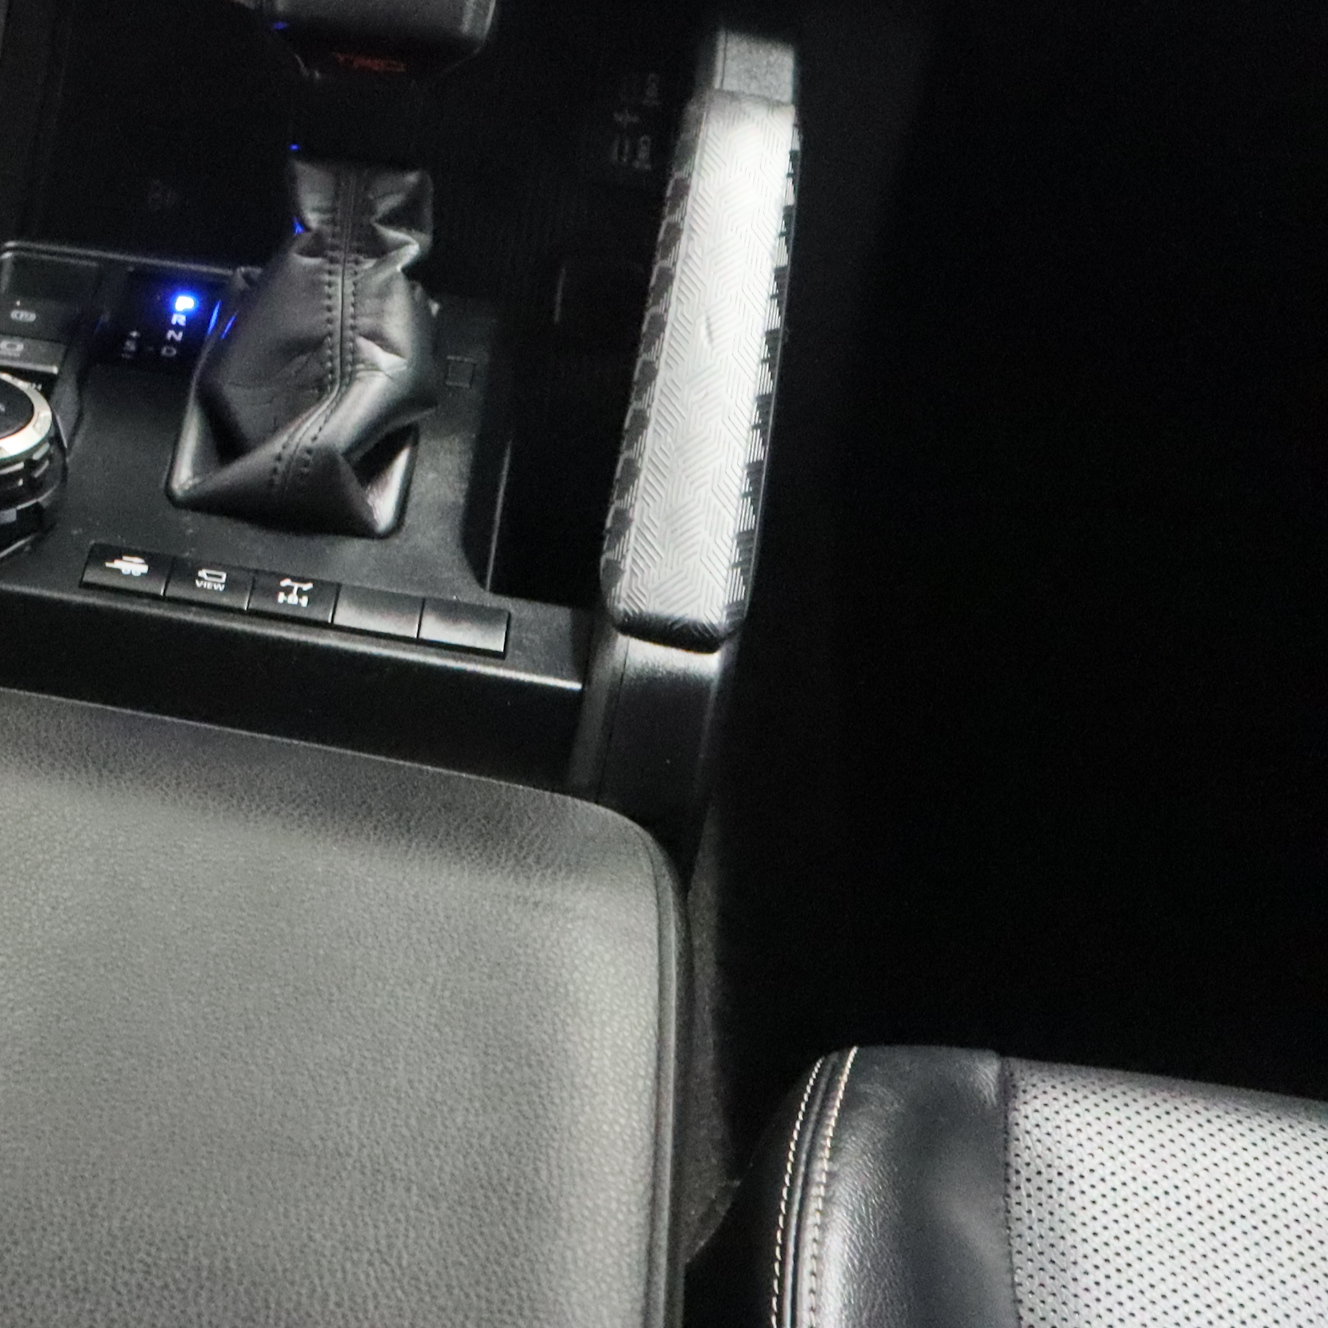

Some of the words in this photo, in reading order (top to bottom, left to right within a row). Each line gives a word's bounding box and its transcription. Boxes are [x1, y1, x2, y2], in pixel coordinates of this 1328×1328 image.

[174, 294, 195, 312] P
[170, 313, 187, 327] R
[165, 329, 184, 343] N
[195, 578, 226, 592] VIEW
